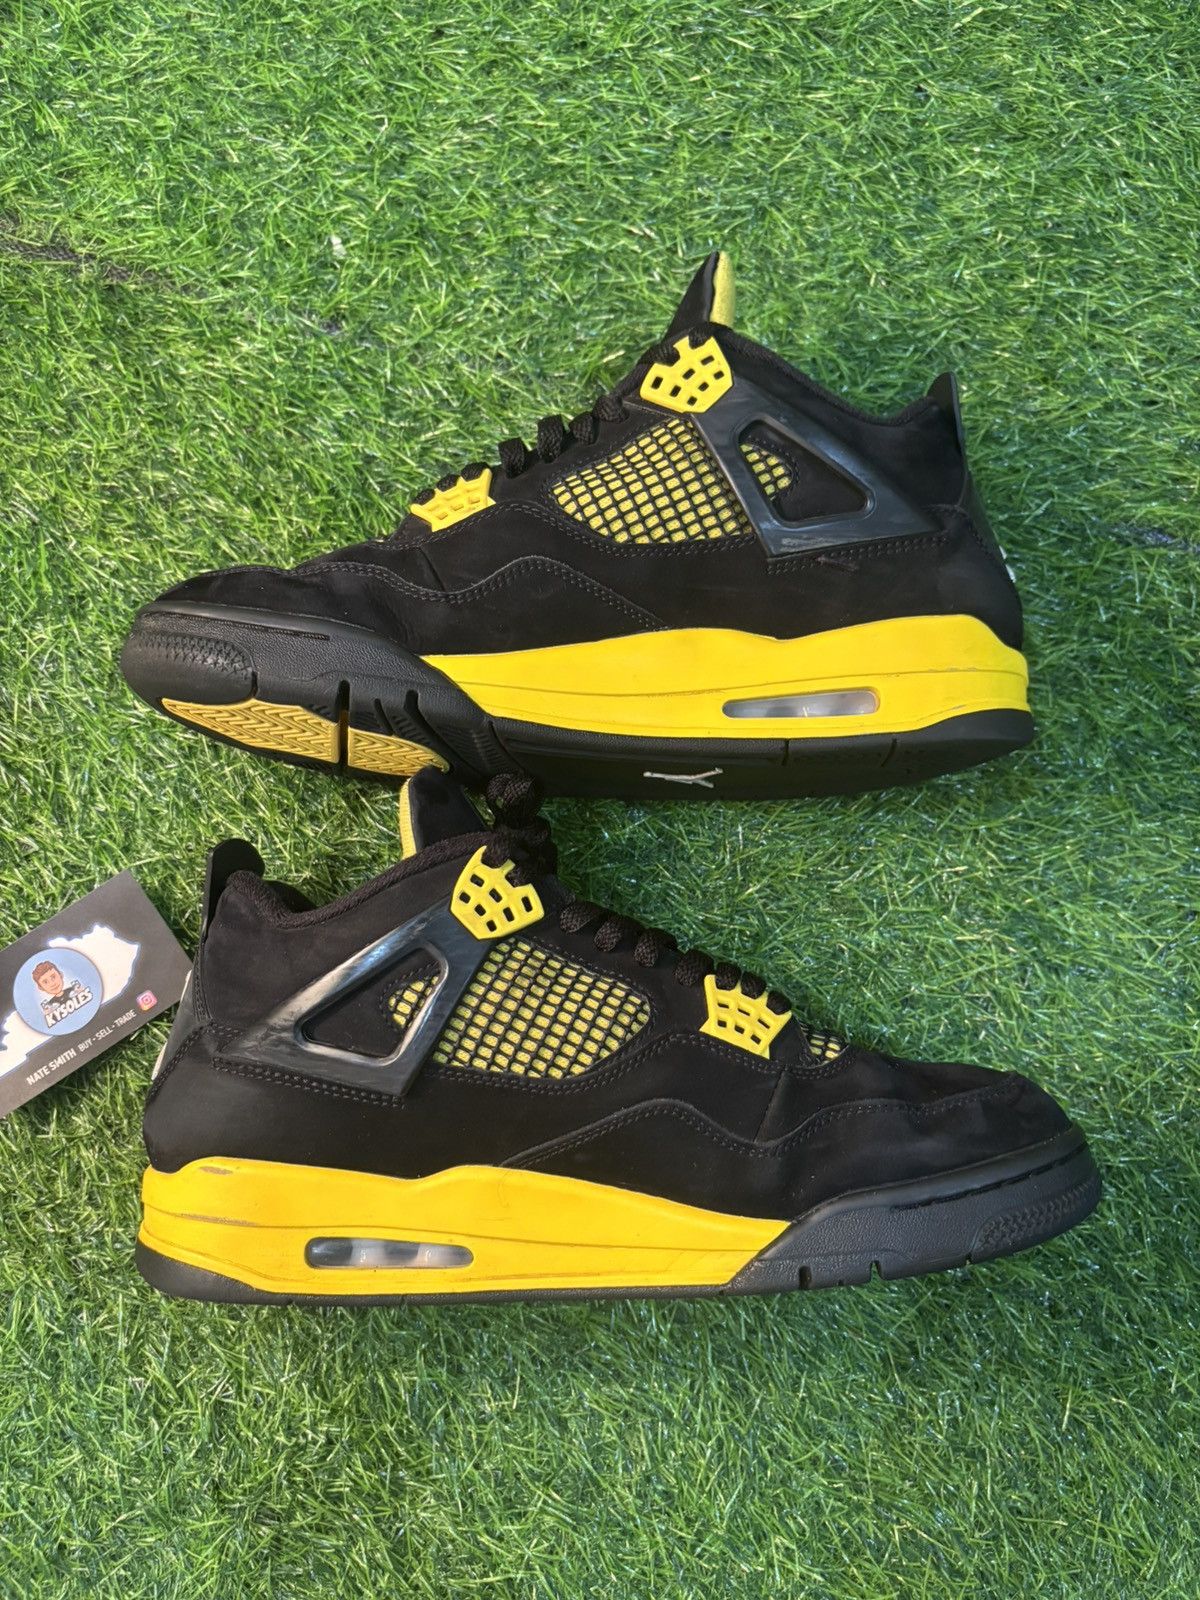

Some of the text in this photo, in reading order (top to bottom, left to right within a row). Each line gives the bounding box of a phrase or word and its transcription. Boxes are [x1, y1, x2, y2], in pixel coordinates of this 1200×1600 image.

[45, 987, 94, 1028] KYSOLES
[26, 1009, 137, 1086] NATE SMITH BUY SELL TRADE
